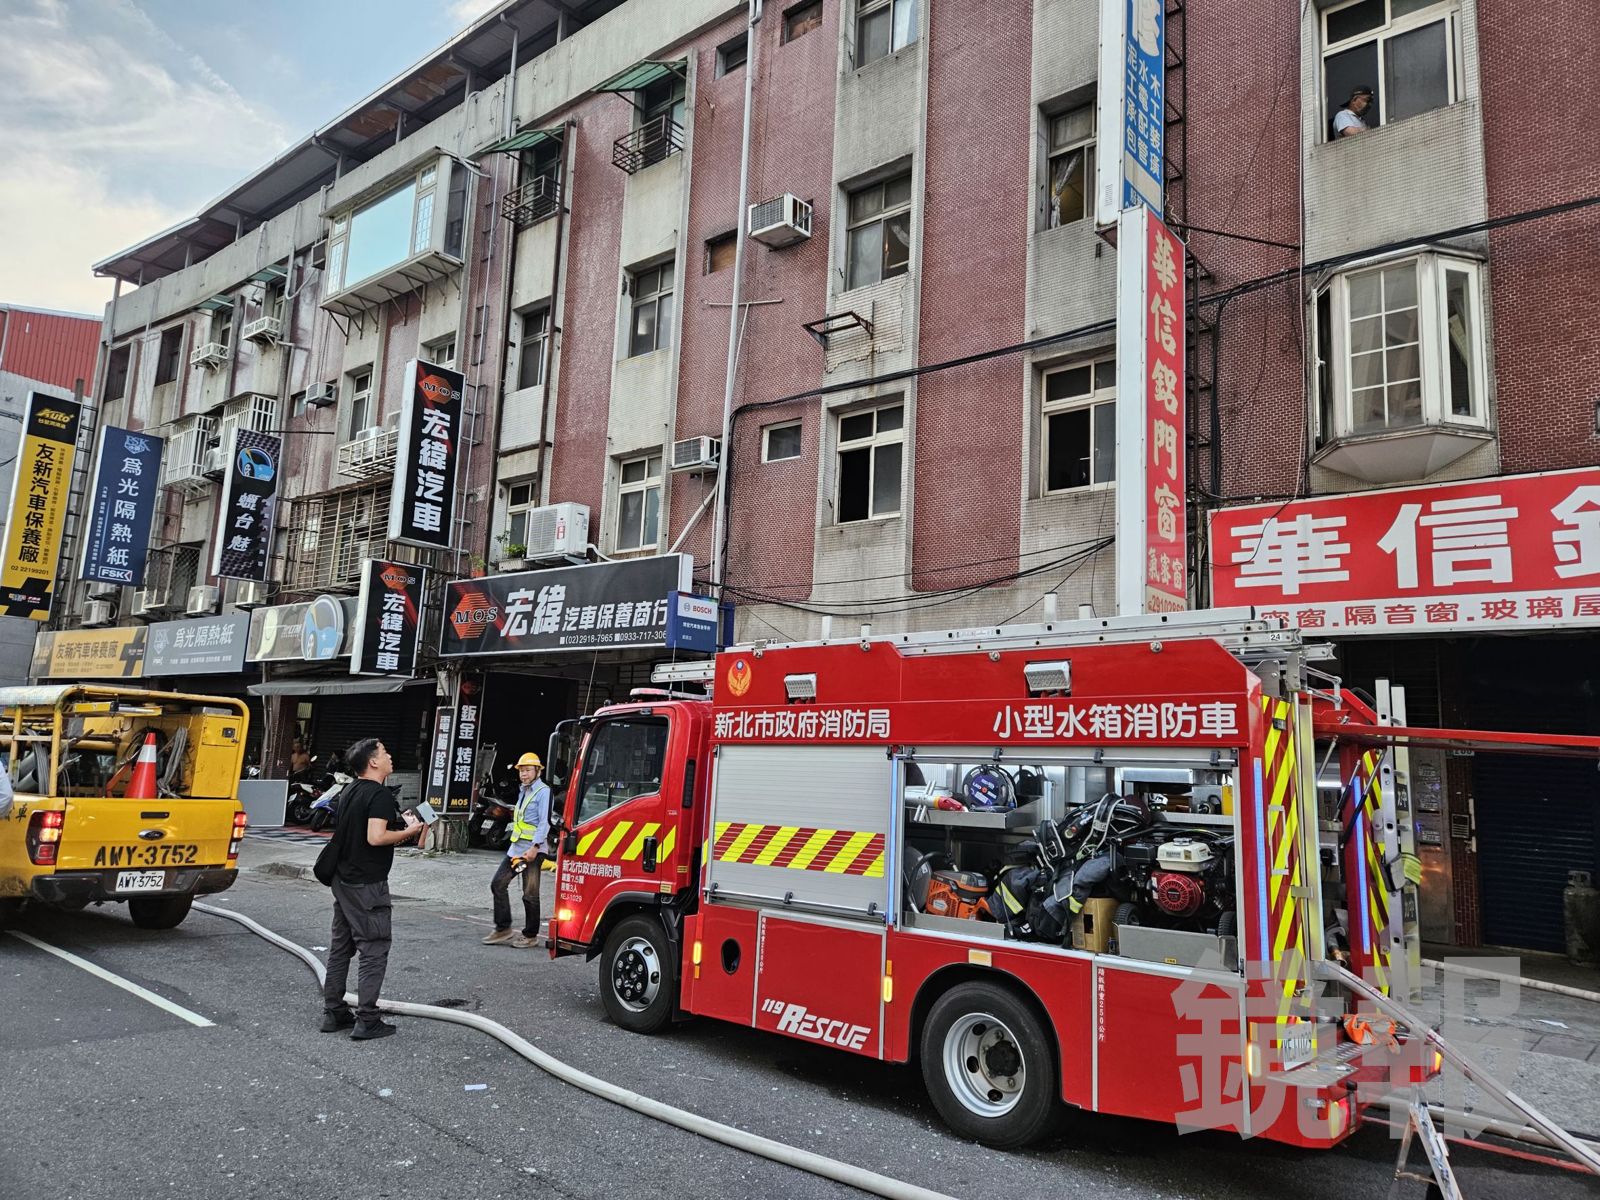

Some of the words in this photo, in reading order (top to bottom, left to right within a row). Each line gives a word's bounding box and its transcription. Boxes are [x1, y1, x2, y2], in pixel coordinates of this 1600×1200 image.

[1138, 58, 1149, 167] 水電配管
[1150, 73, 1161, 180] 木工裝潢
[424, 381, 461, 401] MOS
[1151, 230, 1178, 543] 華信鋁門窗
[412, 407, 451, 533] 宏緯汽車
[18, 443, 56, 565] 友新汽車保養廠
[101, 569, 125, 578] FSK
[383, 573, 416, 585] MOS
[455, 606, 498, 624] MOS
[500, 584, 567, 637] 宏緯
[561, 599, 668, 632] 汽車保養商行
[692, 605, 712, 614] BOSCH
[375, 593, 406, 670] 宏緯汽車
[565, 633, 613, 644] (02)2918-7965
[1270, 633, 1280, 641] 24
[55, 640, 119, 659] 友新汽車保養廠
[459, 705, 477, 739] 鈑金
[714, 709, 890, 739] 新北市政府消防局
[993, 701, 1239, 739] 小型水箱消防車
[432, 715, 451, 787] 電腦診斷
[454, 747, 472, 782] 烤漆
[430, 797, 441, 806] MOS
[450, 798, 468, 806] MOS
[94, 844, 199, 867] AWY-3752
[117, 874, 163, 889] AWY-3752
[562, 860, 621, 879] 新北市政府消防局
[761, 998, 785, 1014] 119
[776, 1003, 871, 1050] RESCUE
